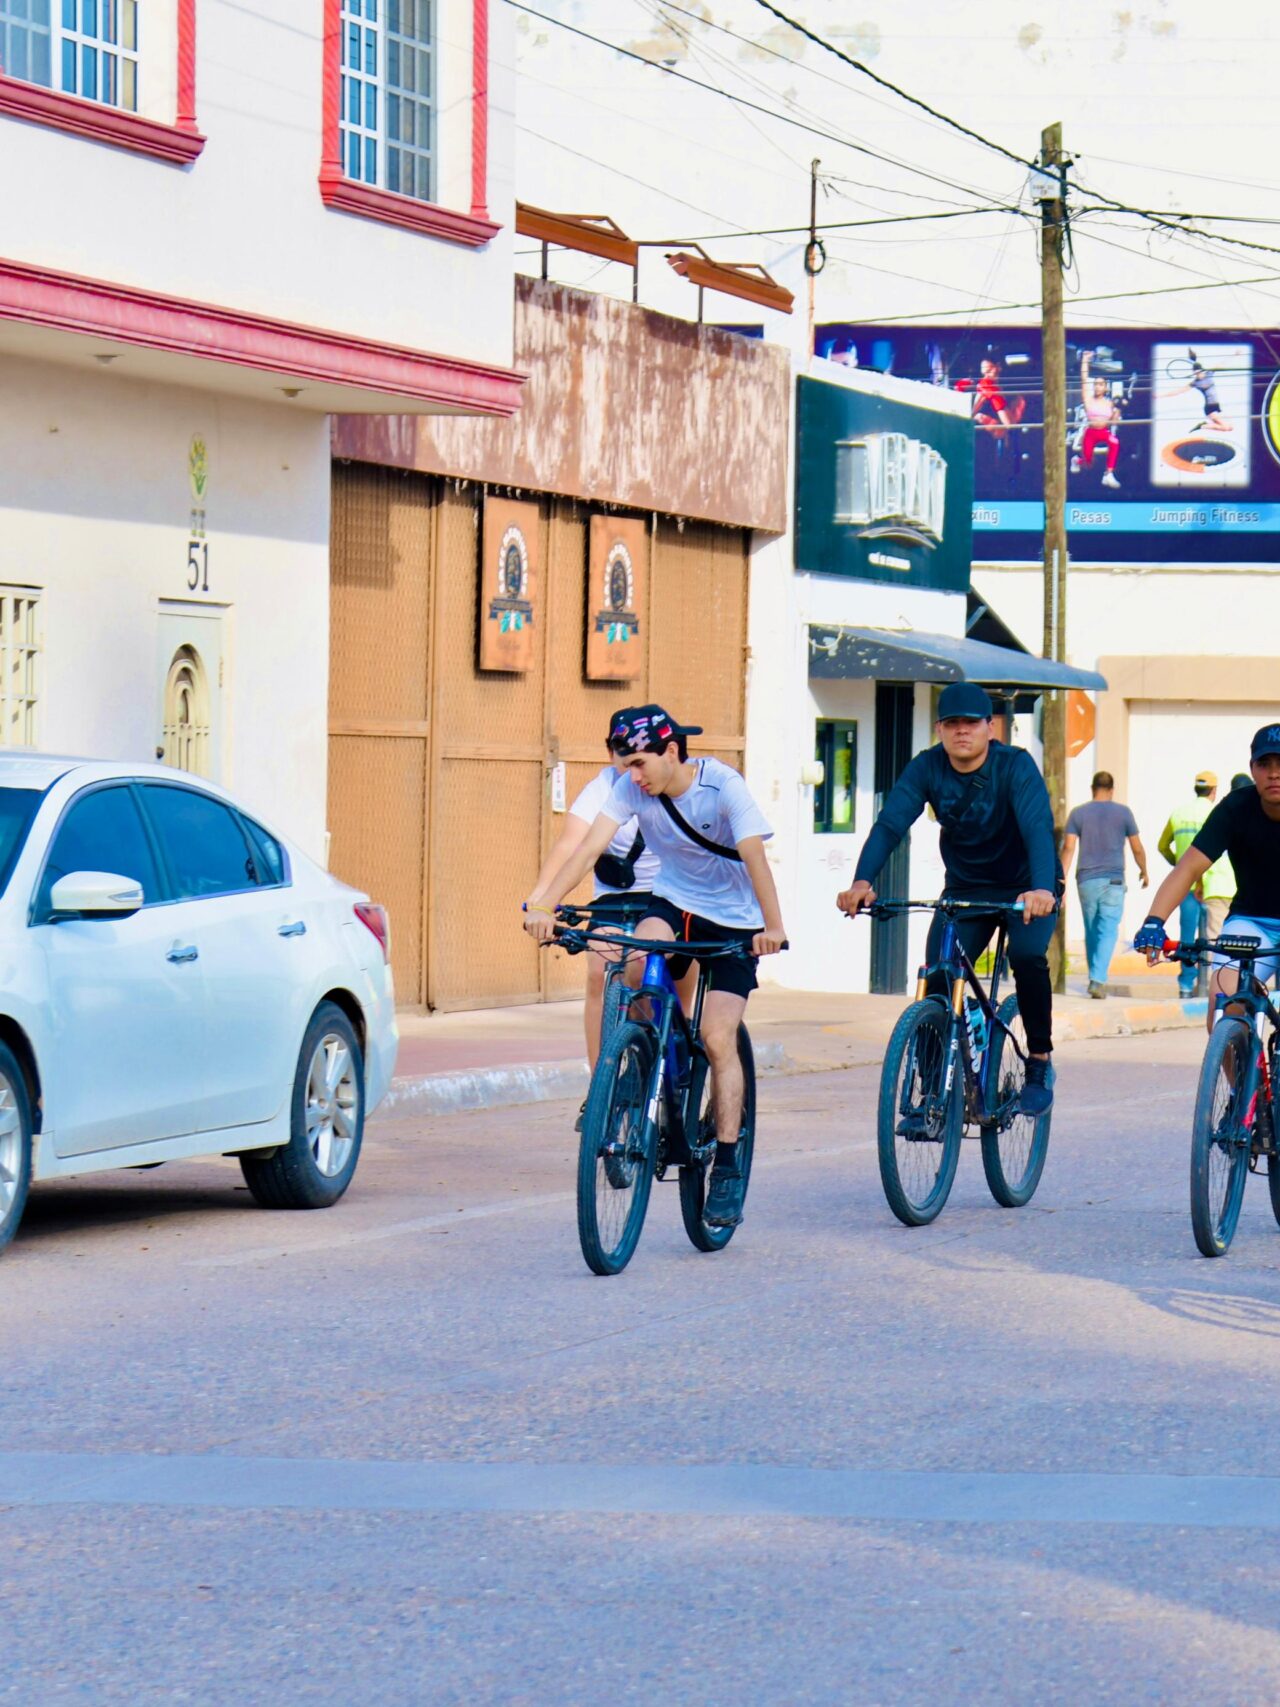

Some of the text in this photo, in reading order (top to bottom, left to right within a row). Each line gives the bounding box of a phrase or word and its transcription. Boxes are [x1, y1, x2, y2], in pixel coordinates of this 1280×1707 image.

[1071, 510, 1110, 523] Pesas
[1151, 508, 1259, 526] Jumping Fitness
[187, 541, 209, 591] 51
